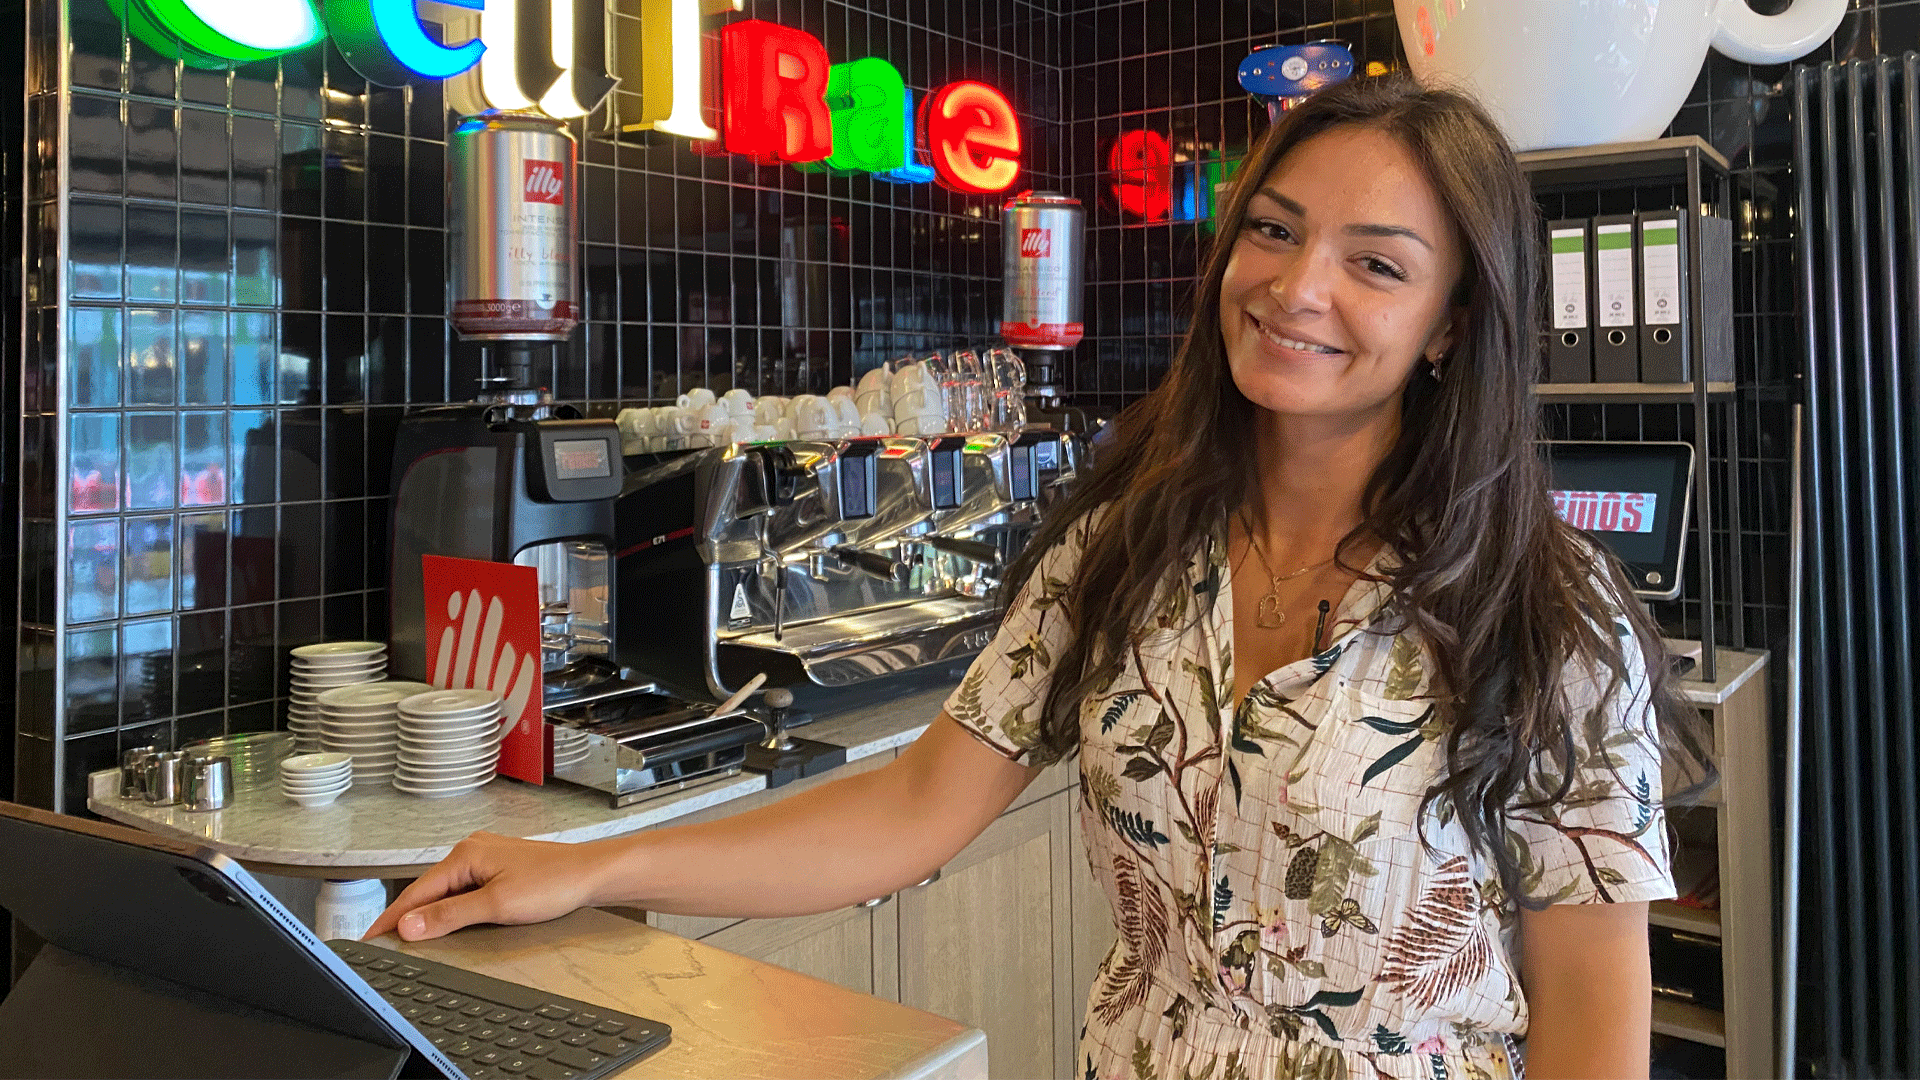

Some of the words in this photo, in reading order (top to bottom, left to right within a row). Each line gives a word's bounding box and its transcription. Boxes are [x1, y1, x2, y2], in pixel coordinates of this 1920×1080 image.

[526, 167, 561, 200] illy
[508, 247, 533, 261] illy
[1023, 232, 1050, 256] illy
[432, 588, 536, 742] illy
